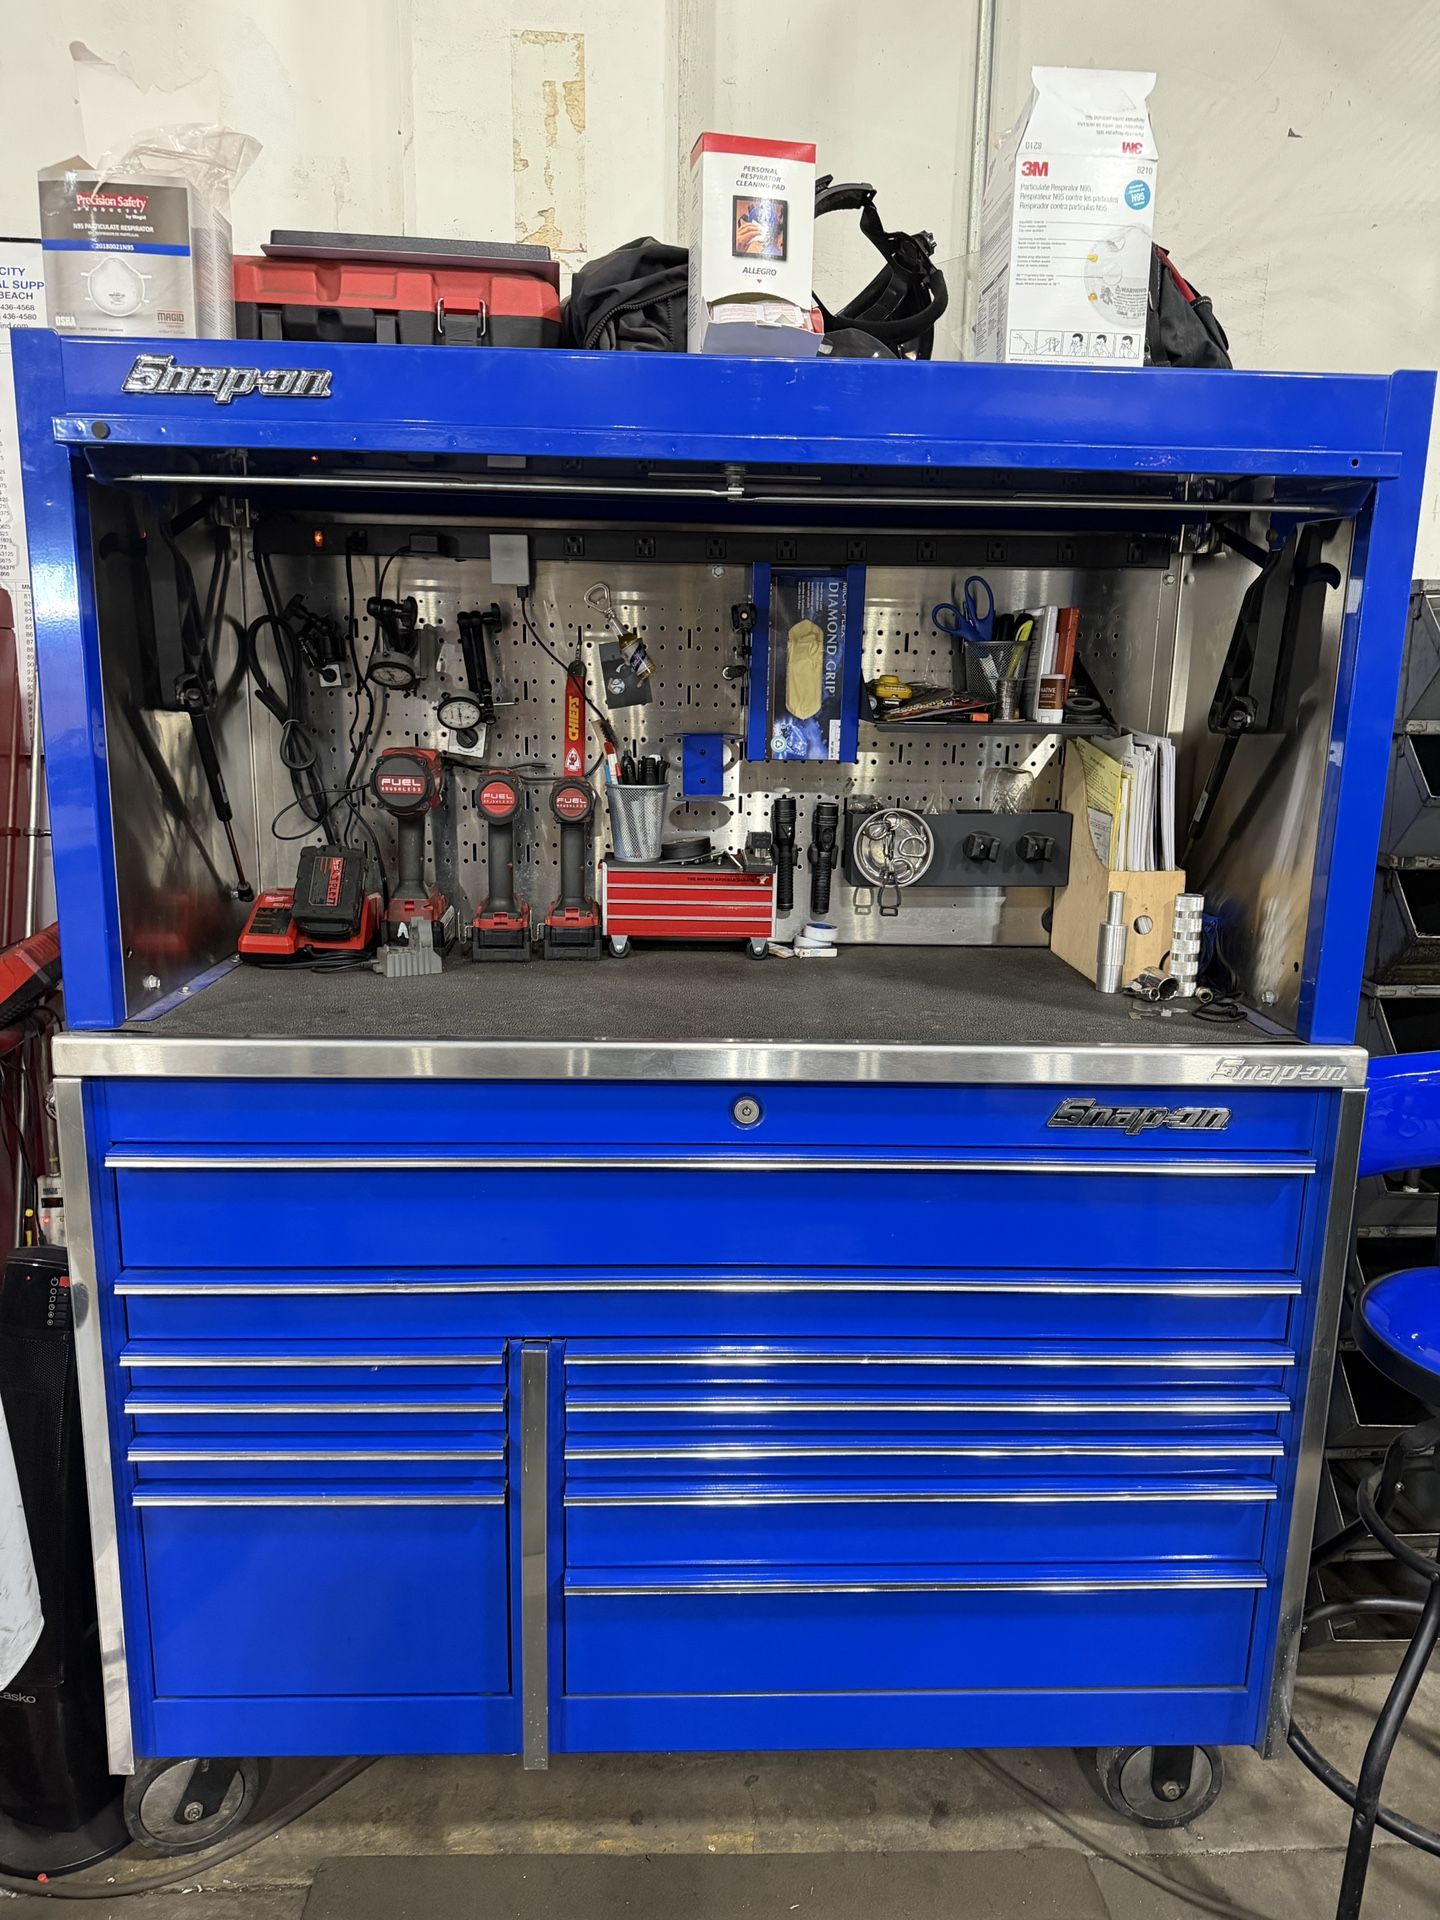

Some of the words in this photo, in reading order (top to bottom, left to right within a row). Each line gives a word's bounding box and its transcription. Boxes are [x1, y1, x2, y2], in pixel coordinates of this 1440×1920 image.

[1025, 141, 1042, 149] 8210
[1122, 142, 1143, 154] 3M
[742, 165, 778, 175] PERSONAL
[1021, 161, 1049, 177] 3M
[1136, 166, 1153, 175] 8210
[740, 173, 782, 182] RESPIRATOR
[735, 179, 770, 189] CLEANING
[771, 183, 786, 191] PAD
[1131, 192, 1145, 202] N95
[75, 194, 117, 207] Precision
[117, 196, 147, 213] Safety
[120, 225, 154, 233] RESPIRATOR
[0, 266, 26, 277] CITY
[742, 266, 777, 277] ALLEGRO
[0, 291, 34, 300] BEACH
[157, 312, 185, 322] MAGID
[121, 354, 333, 404] Snap-on
[826, 582, 840, 656] DIAMOND
[825, 660, 837, 694] GRIP
[568, 695, 580, 741] CHIEFS
[381, 778, 422, 787] FUEL
[1208, 1056, 1348, 1085] Snap-on
[1046, 1097, 1233, 1136] Snap-on
